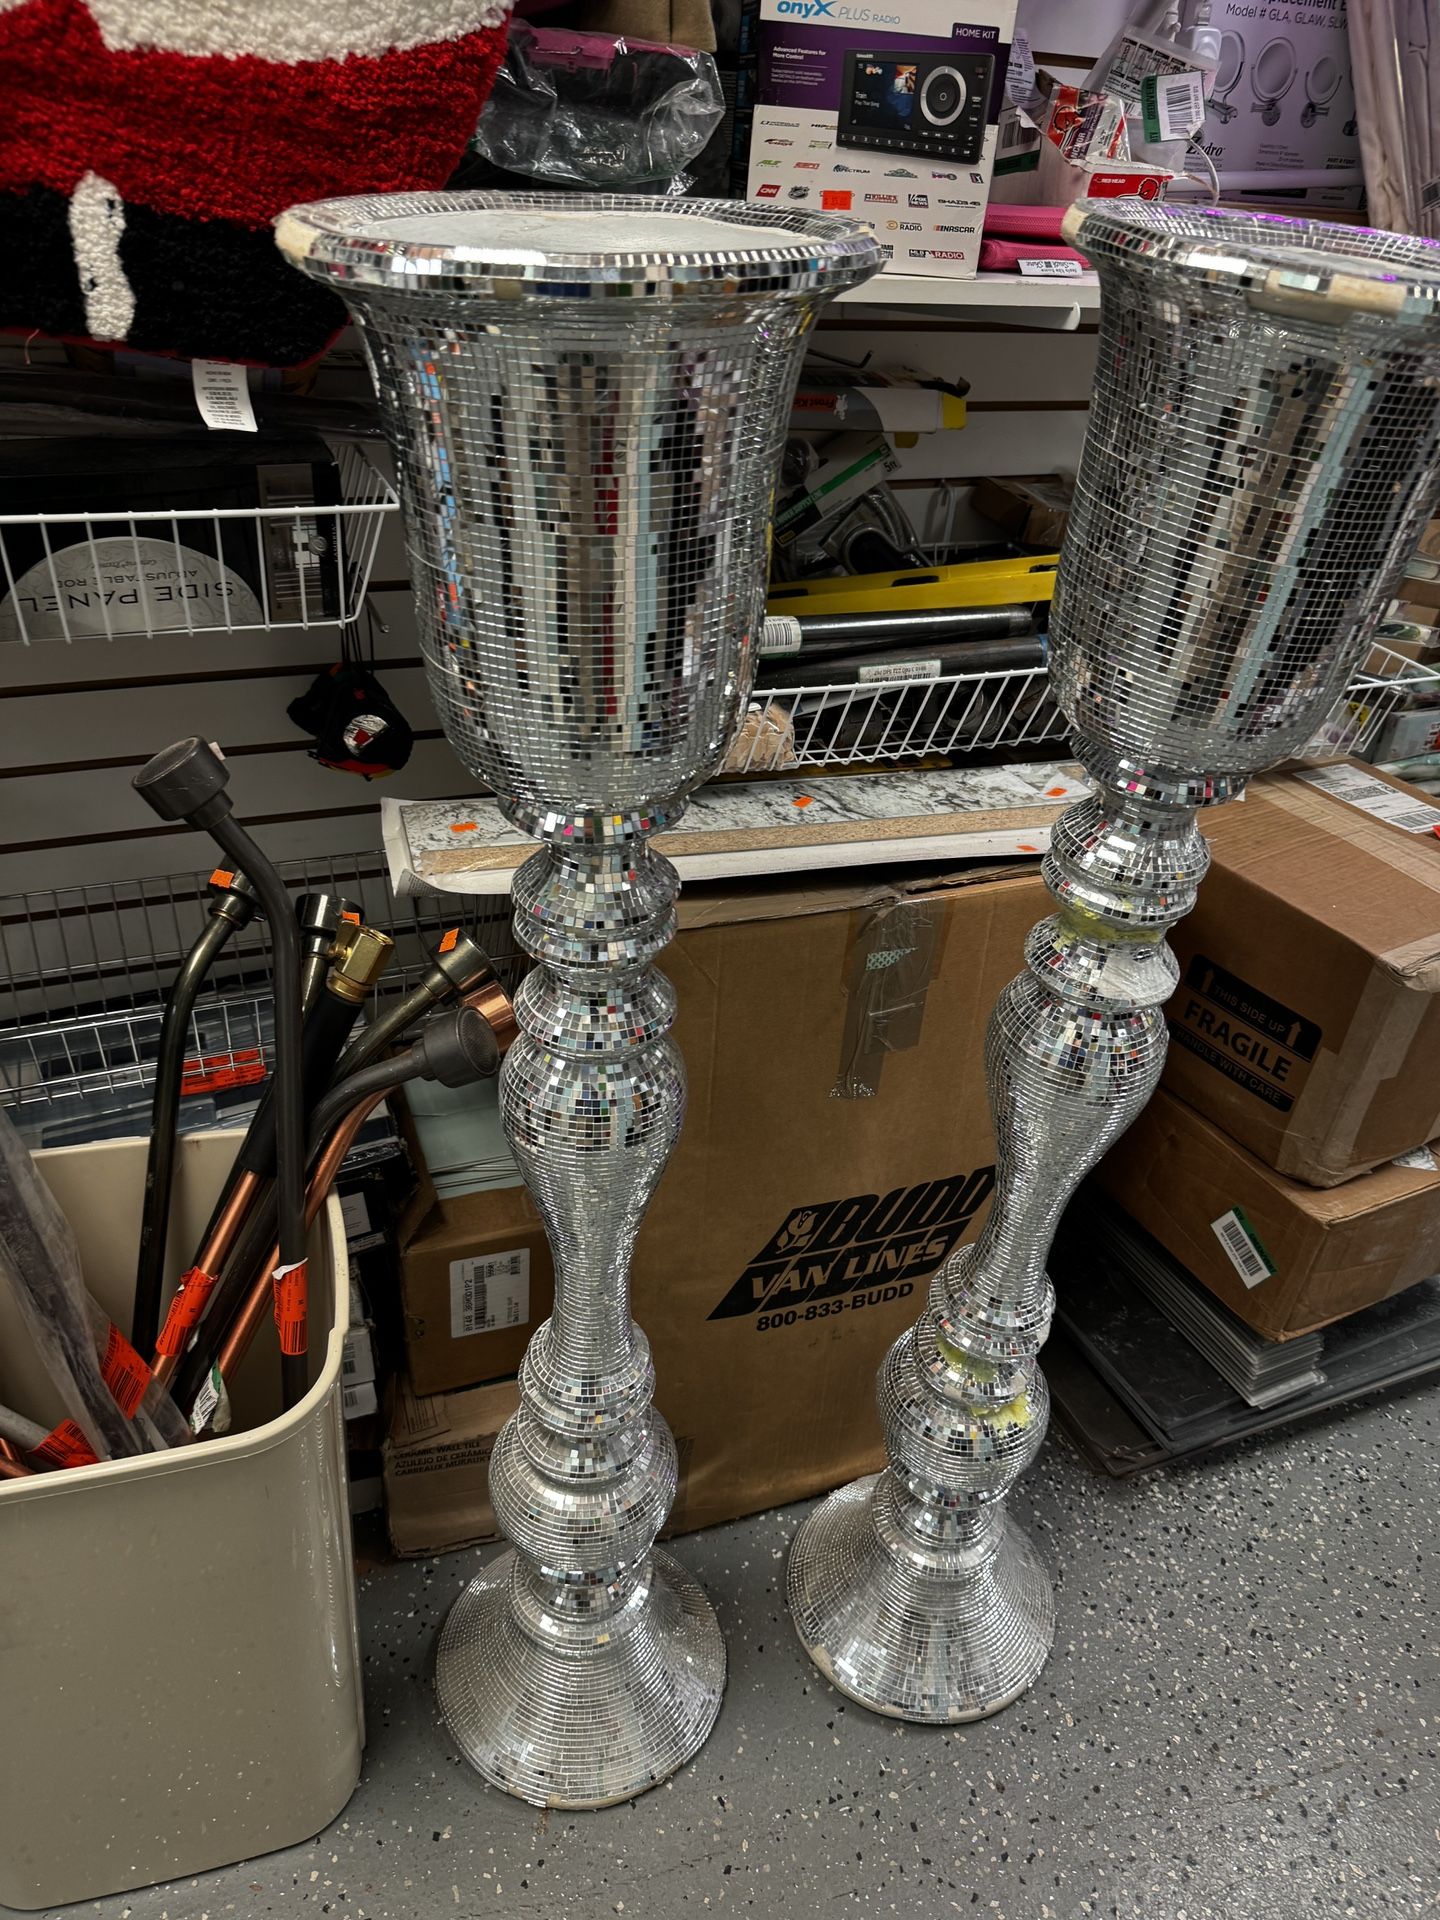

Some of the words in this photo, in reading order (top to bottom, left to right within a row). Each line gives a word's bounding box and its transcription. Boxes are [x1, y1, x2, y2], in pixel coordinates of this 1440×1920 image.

[839, 6, 871, 21] PLUS
[872, 14, 900, 25] RADIO
[1226, 3, 1258, 18] Model
[956, 28, 981, 38] HOME
[982, 30, 996, 39] KIT
[900, 223, 923, 232] RADIO
[940, 225, 975, 234] NASCAR
[934, 251, 964, 260] RADIO
[883, 459, 898, 473] 5ft
[18, 588, 139, 612] PANEL
[154, 581, 234, 602] SIDE
[1213, 984, 1238, 1007] THIS
[1240, 1001, 1267, 1023] SIDE
[1268, 1018, 1287, 1034] UP
[1183, 1000, 1293, 1083] FRAGILE
[1219, 1058, 1248, 1081] WITH
[1249, 1077, 1282, 1103] CARE
[801, 1164, 996, 1254] BUDD
[752, 1262, 834, 1300] VAN
[842, 1234, 950, 1280] LINES
[756, 1282, 914, 1332] 800-833-BUDD
[436, 1443, 461, 1454] WALL
